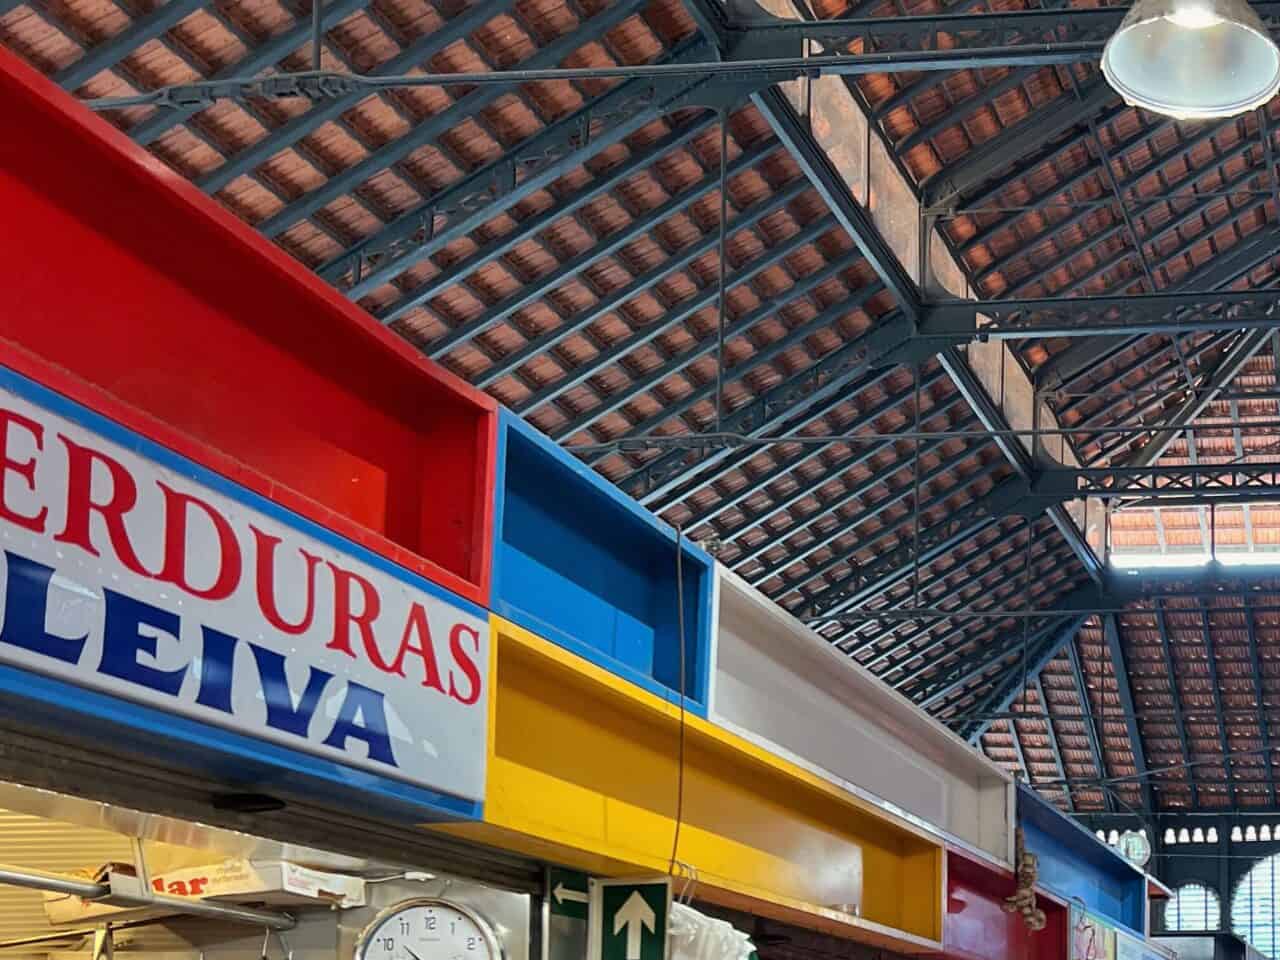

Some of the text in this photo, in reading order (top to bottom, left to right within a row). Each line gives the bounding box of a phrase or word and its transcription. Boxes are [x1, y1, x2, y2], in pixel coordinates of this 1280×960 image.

[0, 550, 398, 768] LEIVA
[400, 922, 411, 936] 11
[424, 916, 437, 931] 12
[383, 938, 395, 951] 10
[466, 938, 476, 951] 2
